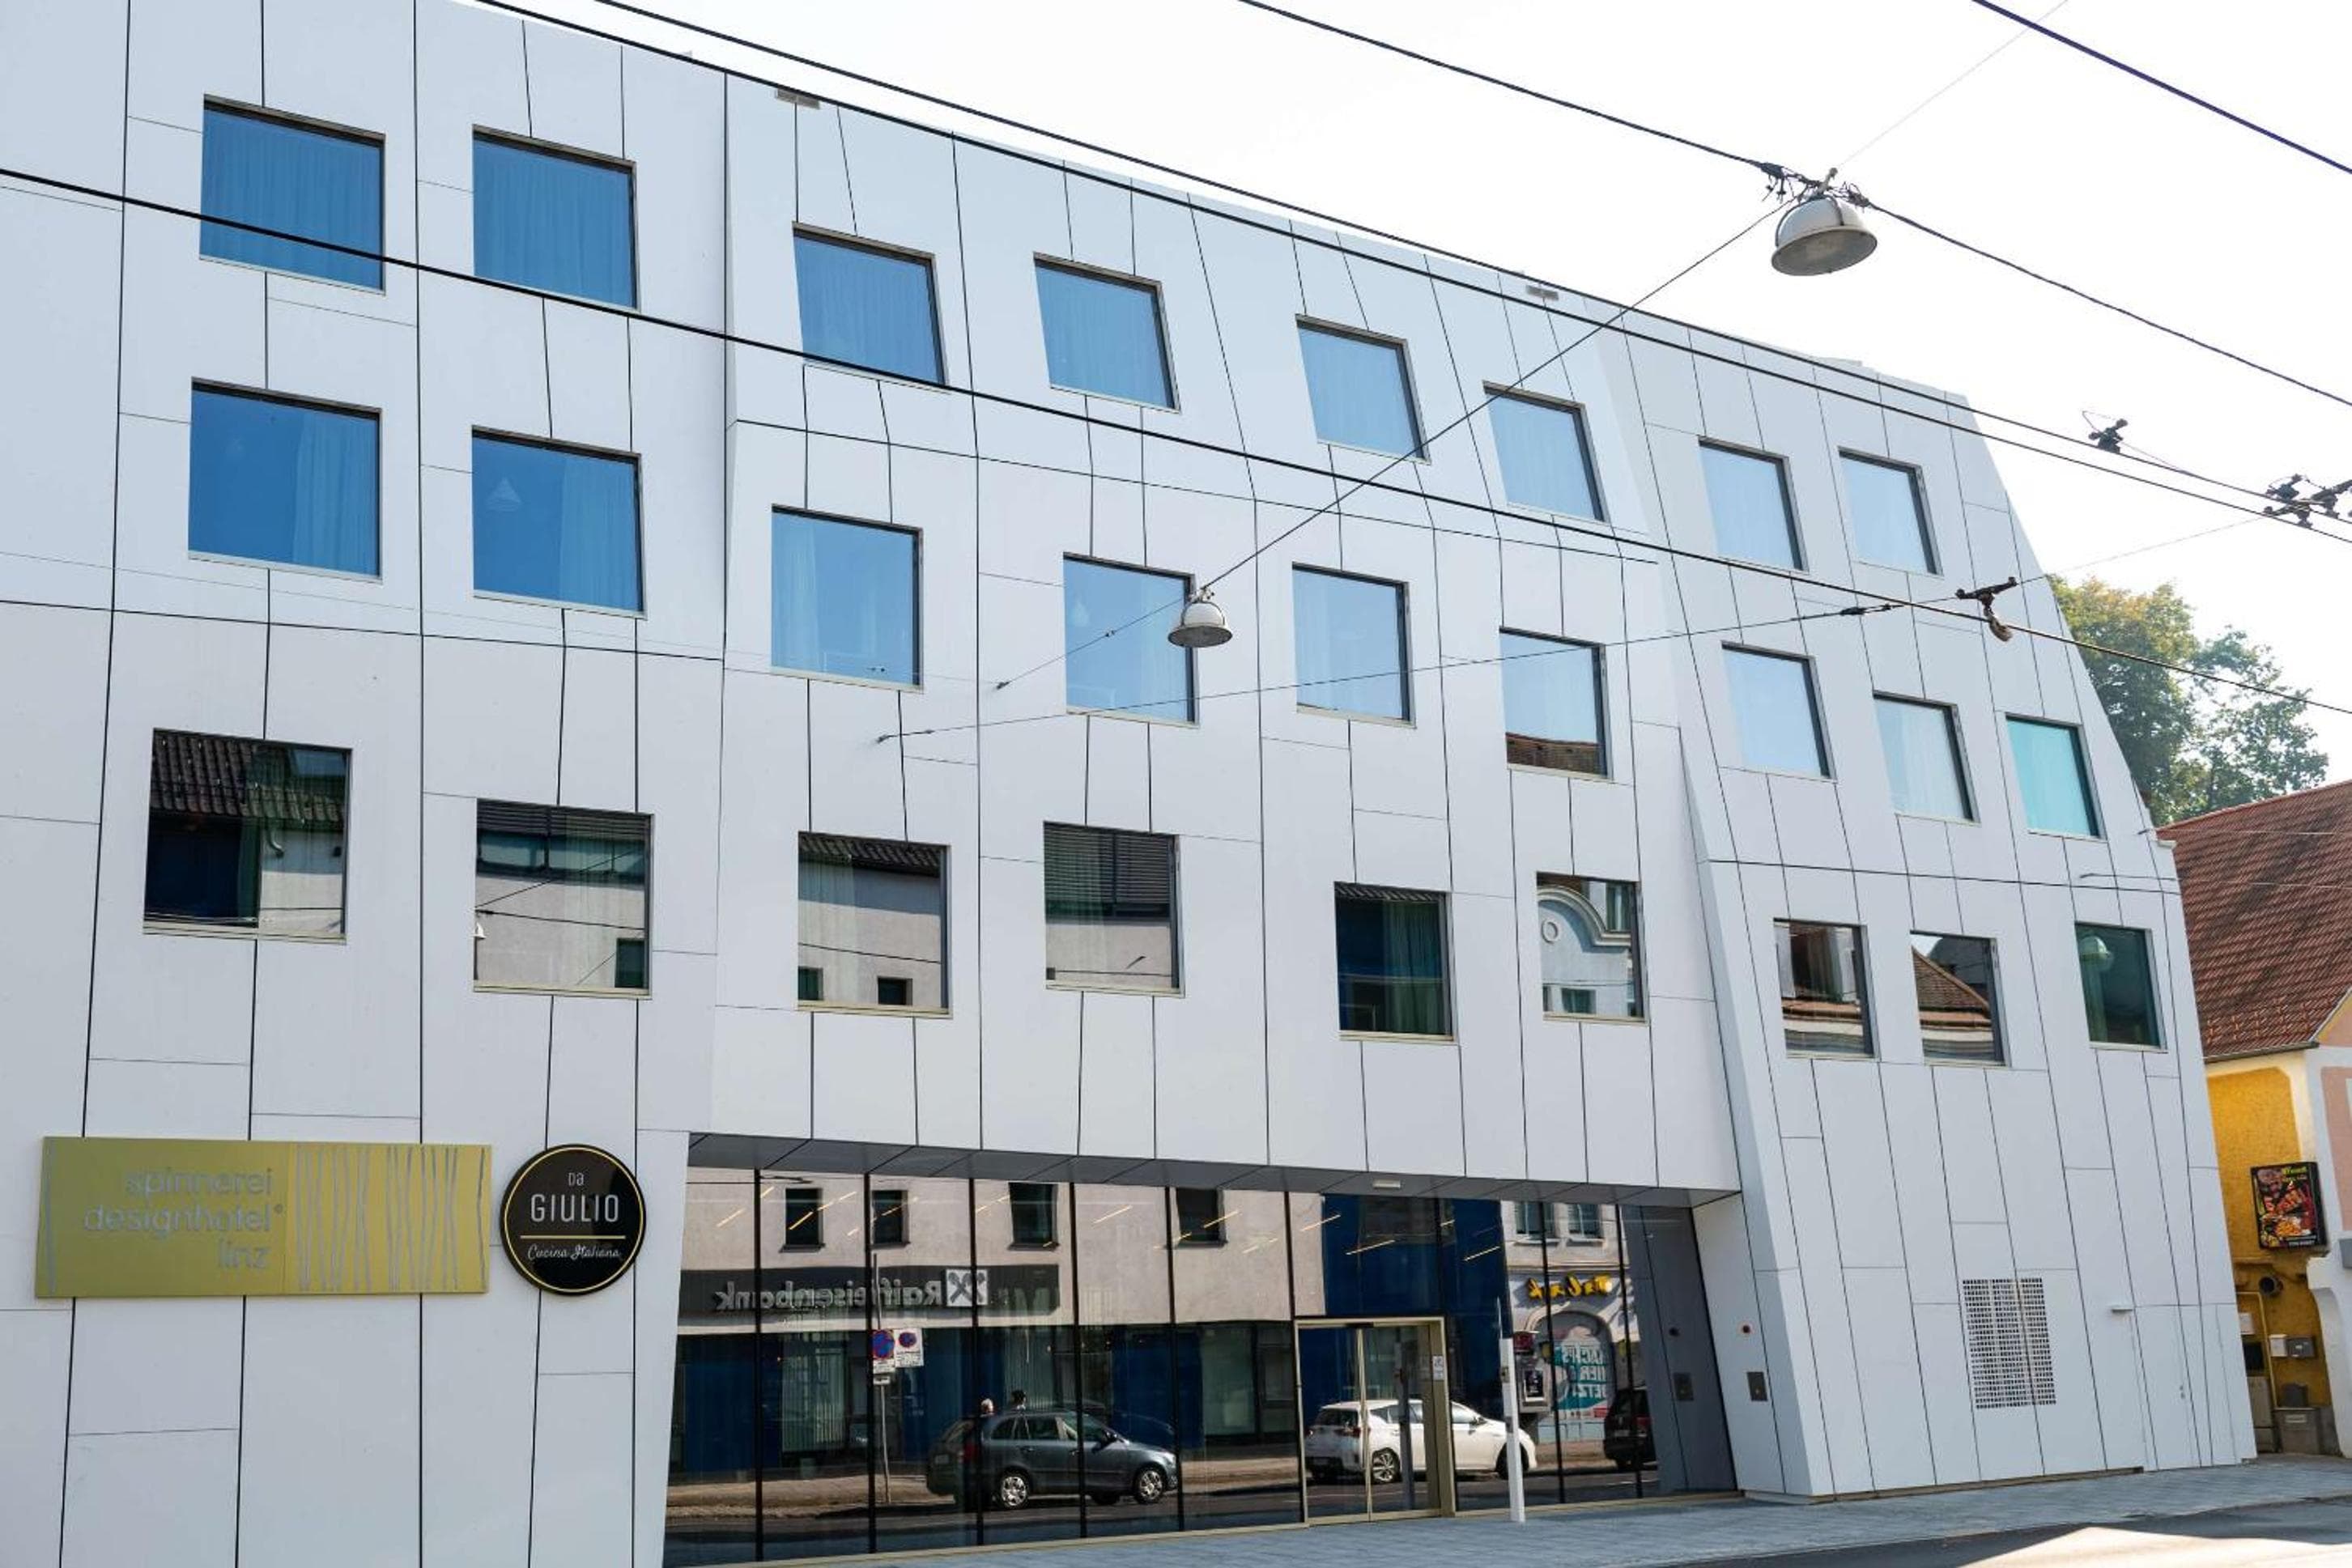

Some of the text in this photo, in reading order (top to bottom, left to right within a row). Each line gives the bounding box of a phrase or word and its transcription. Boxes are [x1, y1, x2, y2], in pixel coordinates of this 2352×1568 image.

[125, 1168, 273, 1198] spinnerei
[530, 1193, 619, 1222] GIULIO
[218, 1239, 270, 1268] linz
[528, 1243, 568, 1260] Cucina
